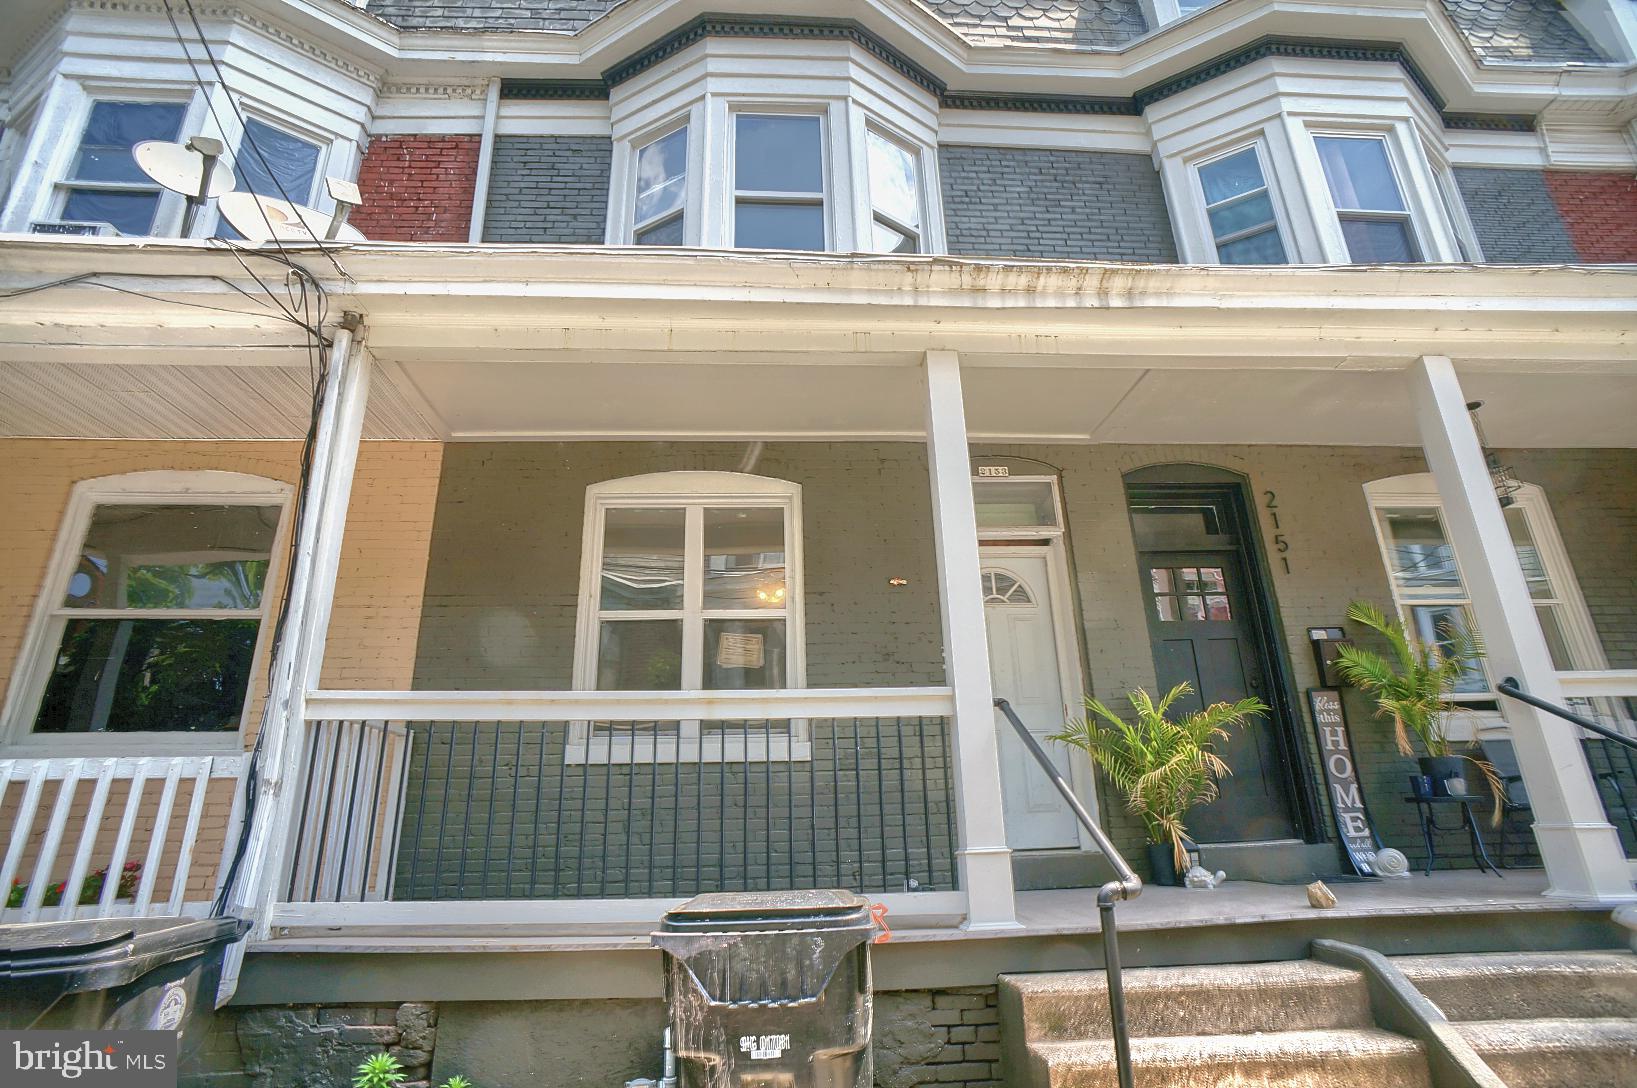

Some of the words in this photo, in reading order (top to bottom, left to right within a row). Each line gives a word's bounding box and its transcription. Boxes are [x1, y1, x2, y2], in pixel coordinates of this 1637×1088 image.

[1263, 490, 1290, 575] 2151
[1317, 712, 1341, 723] this
[1323, 727, 1370, 837] HOME
